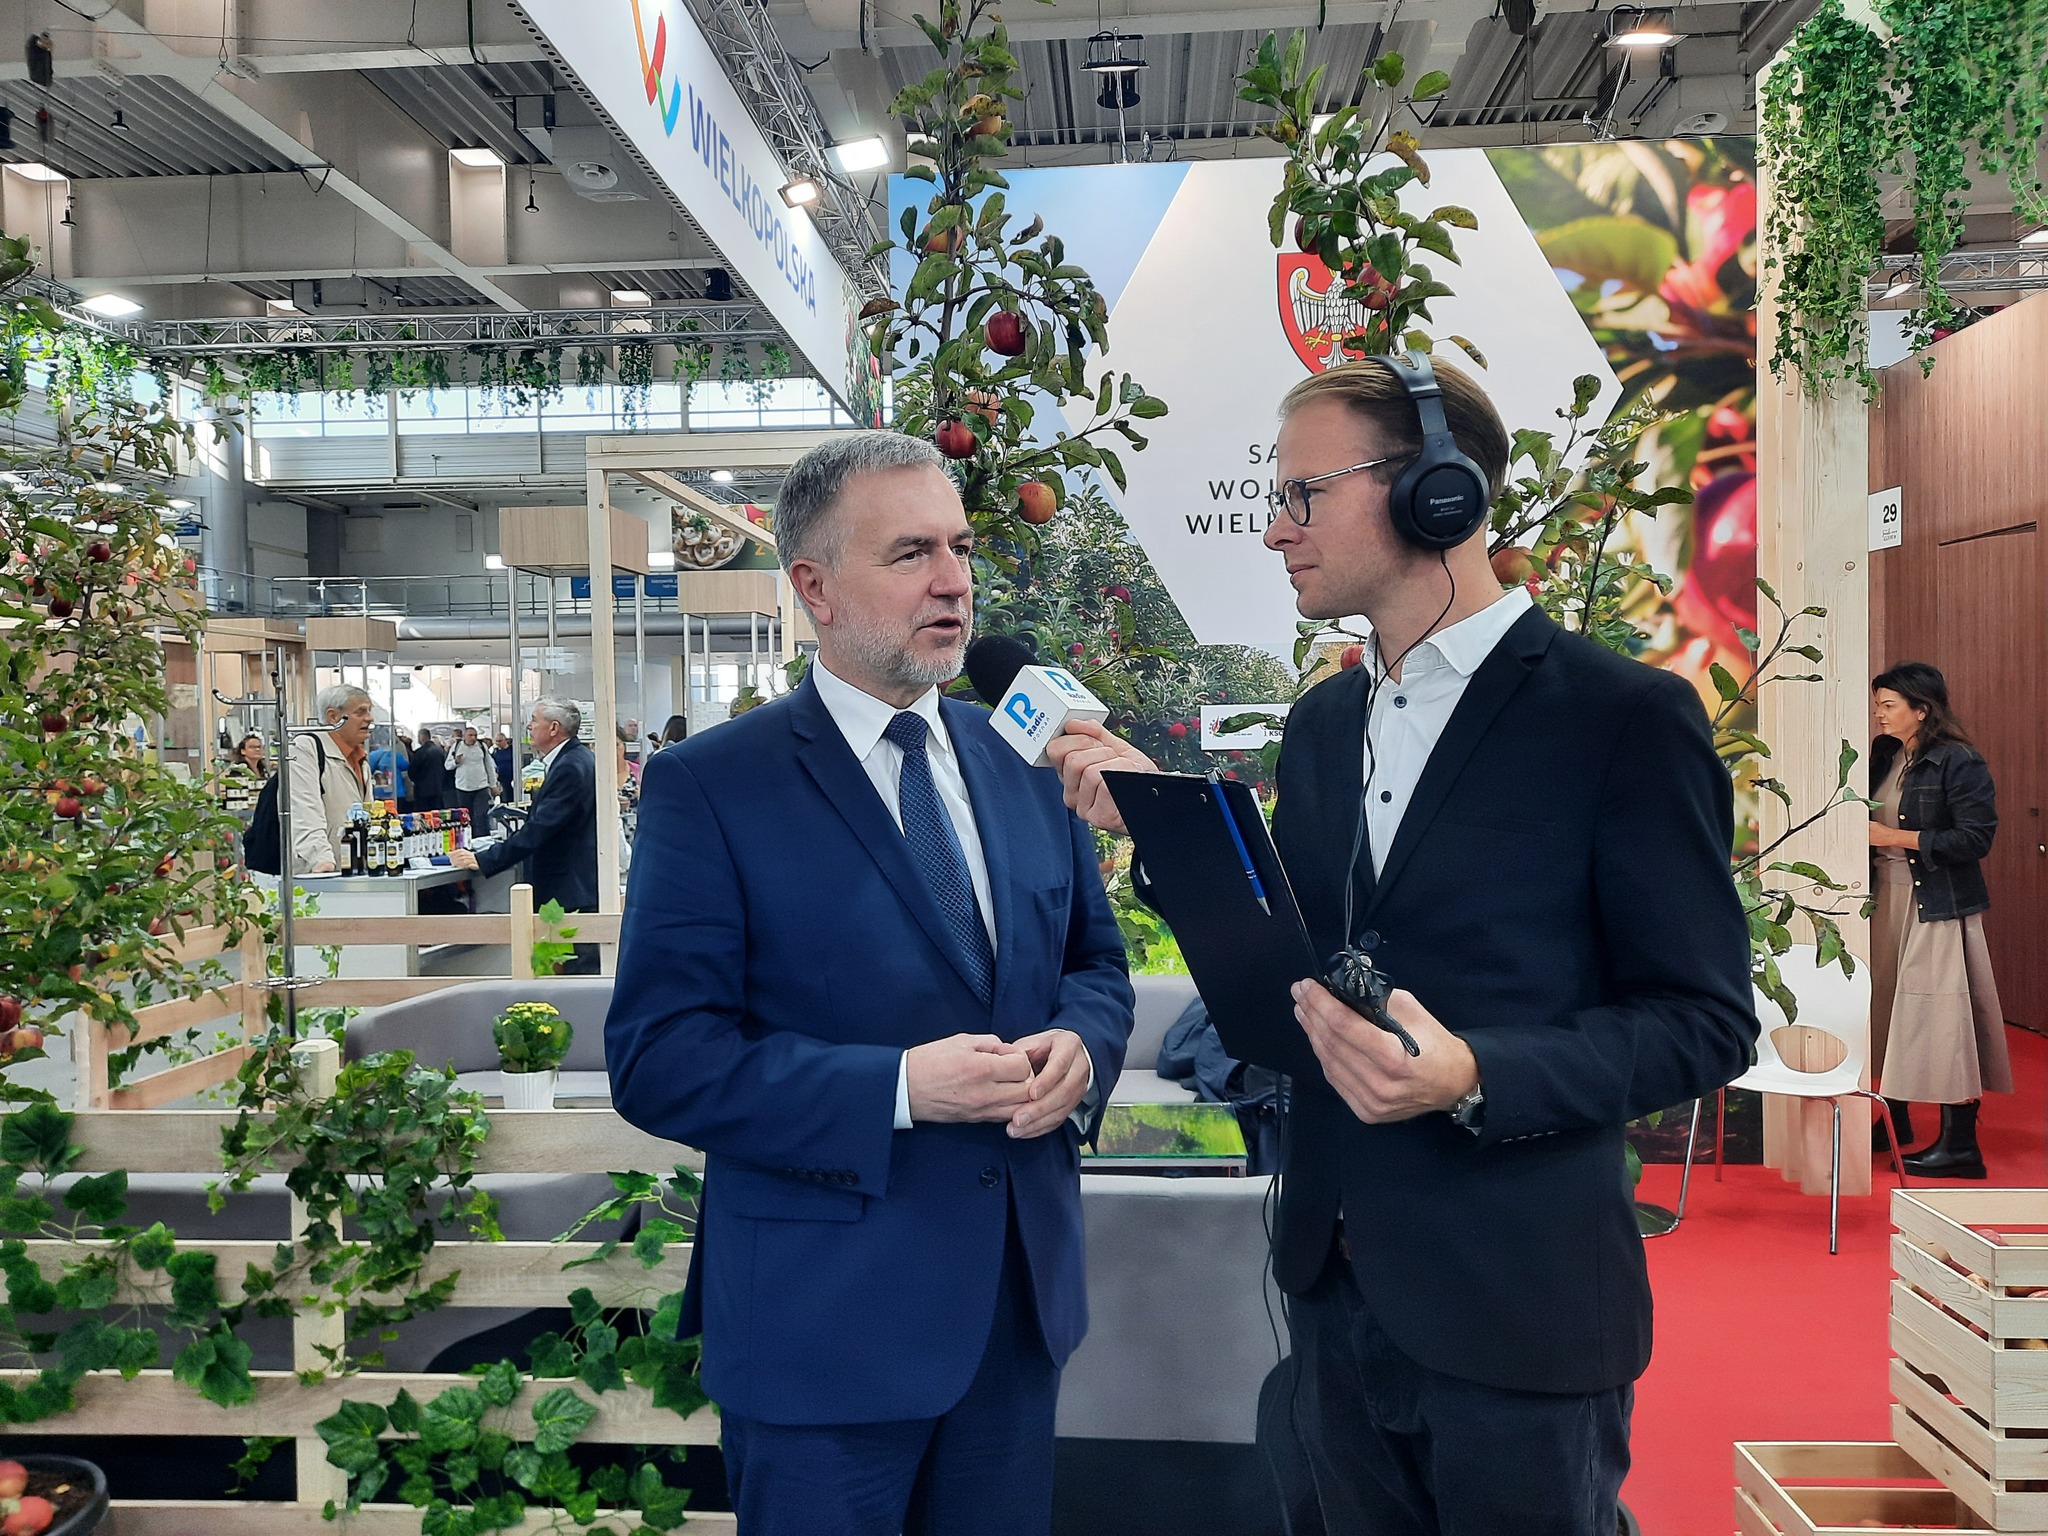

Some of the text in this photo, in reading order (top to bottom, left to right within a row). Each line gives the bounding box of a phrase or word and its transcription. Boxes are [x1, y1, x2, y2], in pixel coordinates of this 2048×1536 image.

[688, 81, 817, 318] WIELKOPOLSKA
[1430, 495, 1464, 505] Panasonic
[1883, 503, 1897, 524] 29
[1026, 711, 1046, 737] Radio
